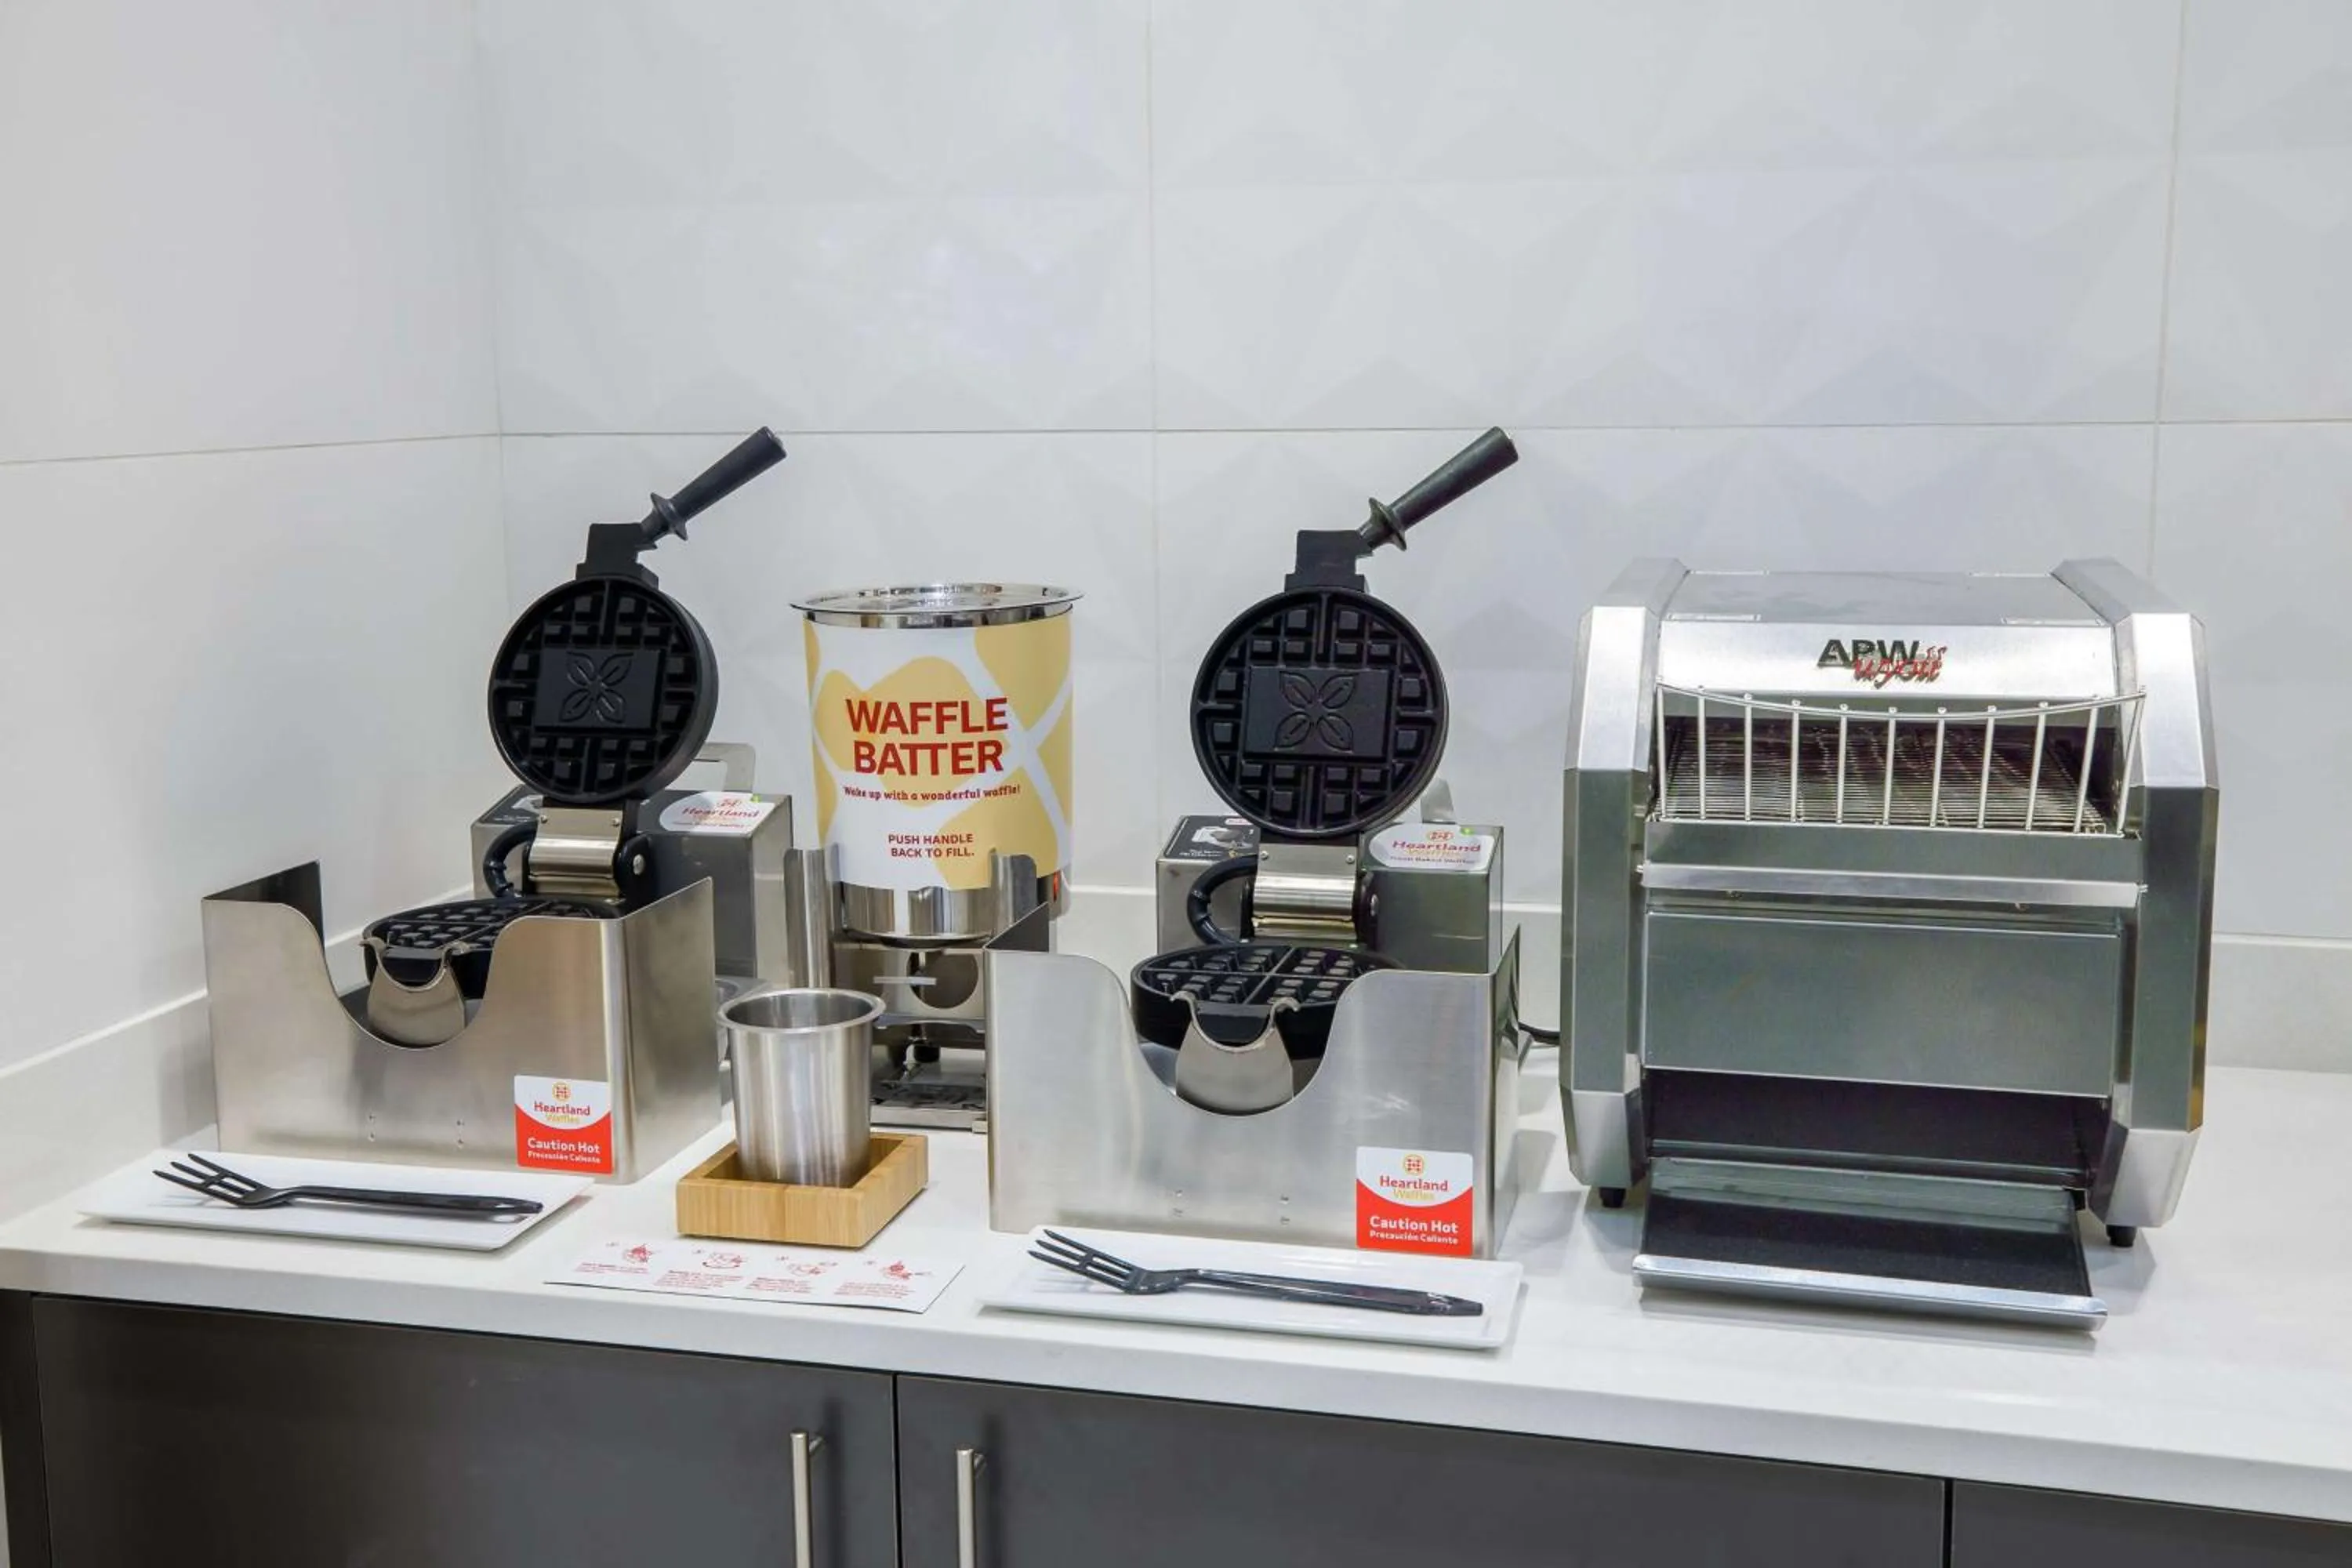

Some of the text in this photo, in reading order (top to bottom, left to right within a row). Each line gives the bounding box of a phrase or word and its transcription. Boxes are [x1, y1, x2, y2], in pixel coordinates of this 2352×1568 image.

[1817, 639, 1920, 668] APW
[845, 698, 1008, 735] WAFFLE
[855, 739, 1004, 775] BATTER
[844, 786, 866, 797] Wake
[869, 791, 880, 800] up
[884, 790, 909, 800] with
[920, 789, 980, 800] wonderful
[983, 784, 1020, 797] waffle!
[888, 833, 974, 844] PUSH HANDLE
[1392, 840, 1481, 852] Heartland
[891, 847, 975, 858] BACK TO FILL.
[534, 1101, 590, 1116] Heartland
[527, 1138, 600, 1154] Caution Hot
[1380, 1175, 1448, 1192] Heartland
[1370, 1216, 1459, 1234] Caution Hot
[1420, 1234, 1458, 1244] Caliente
